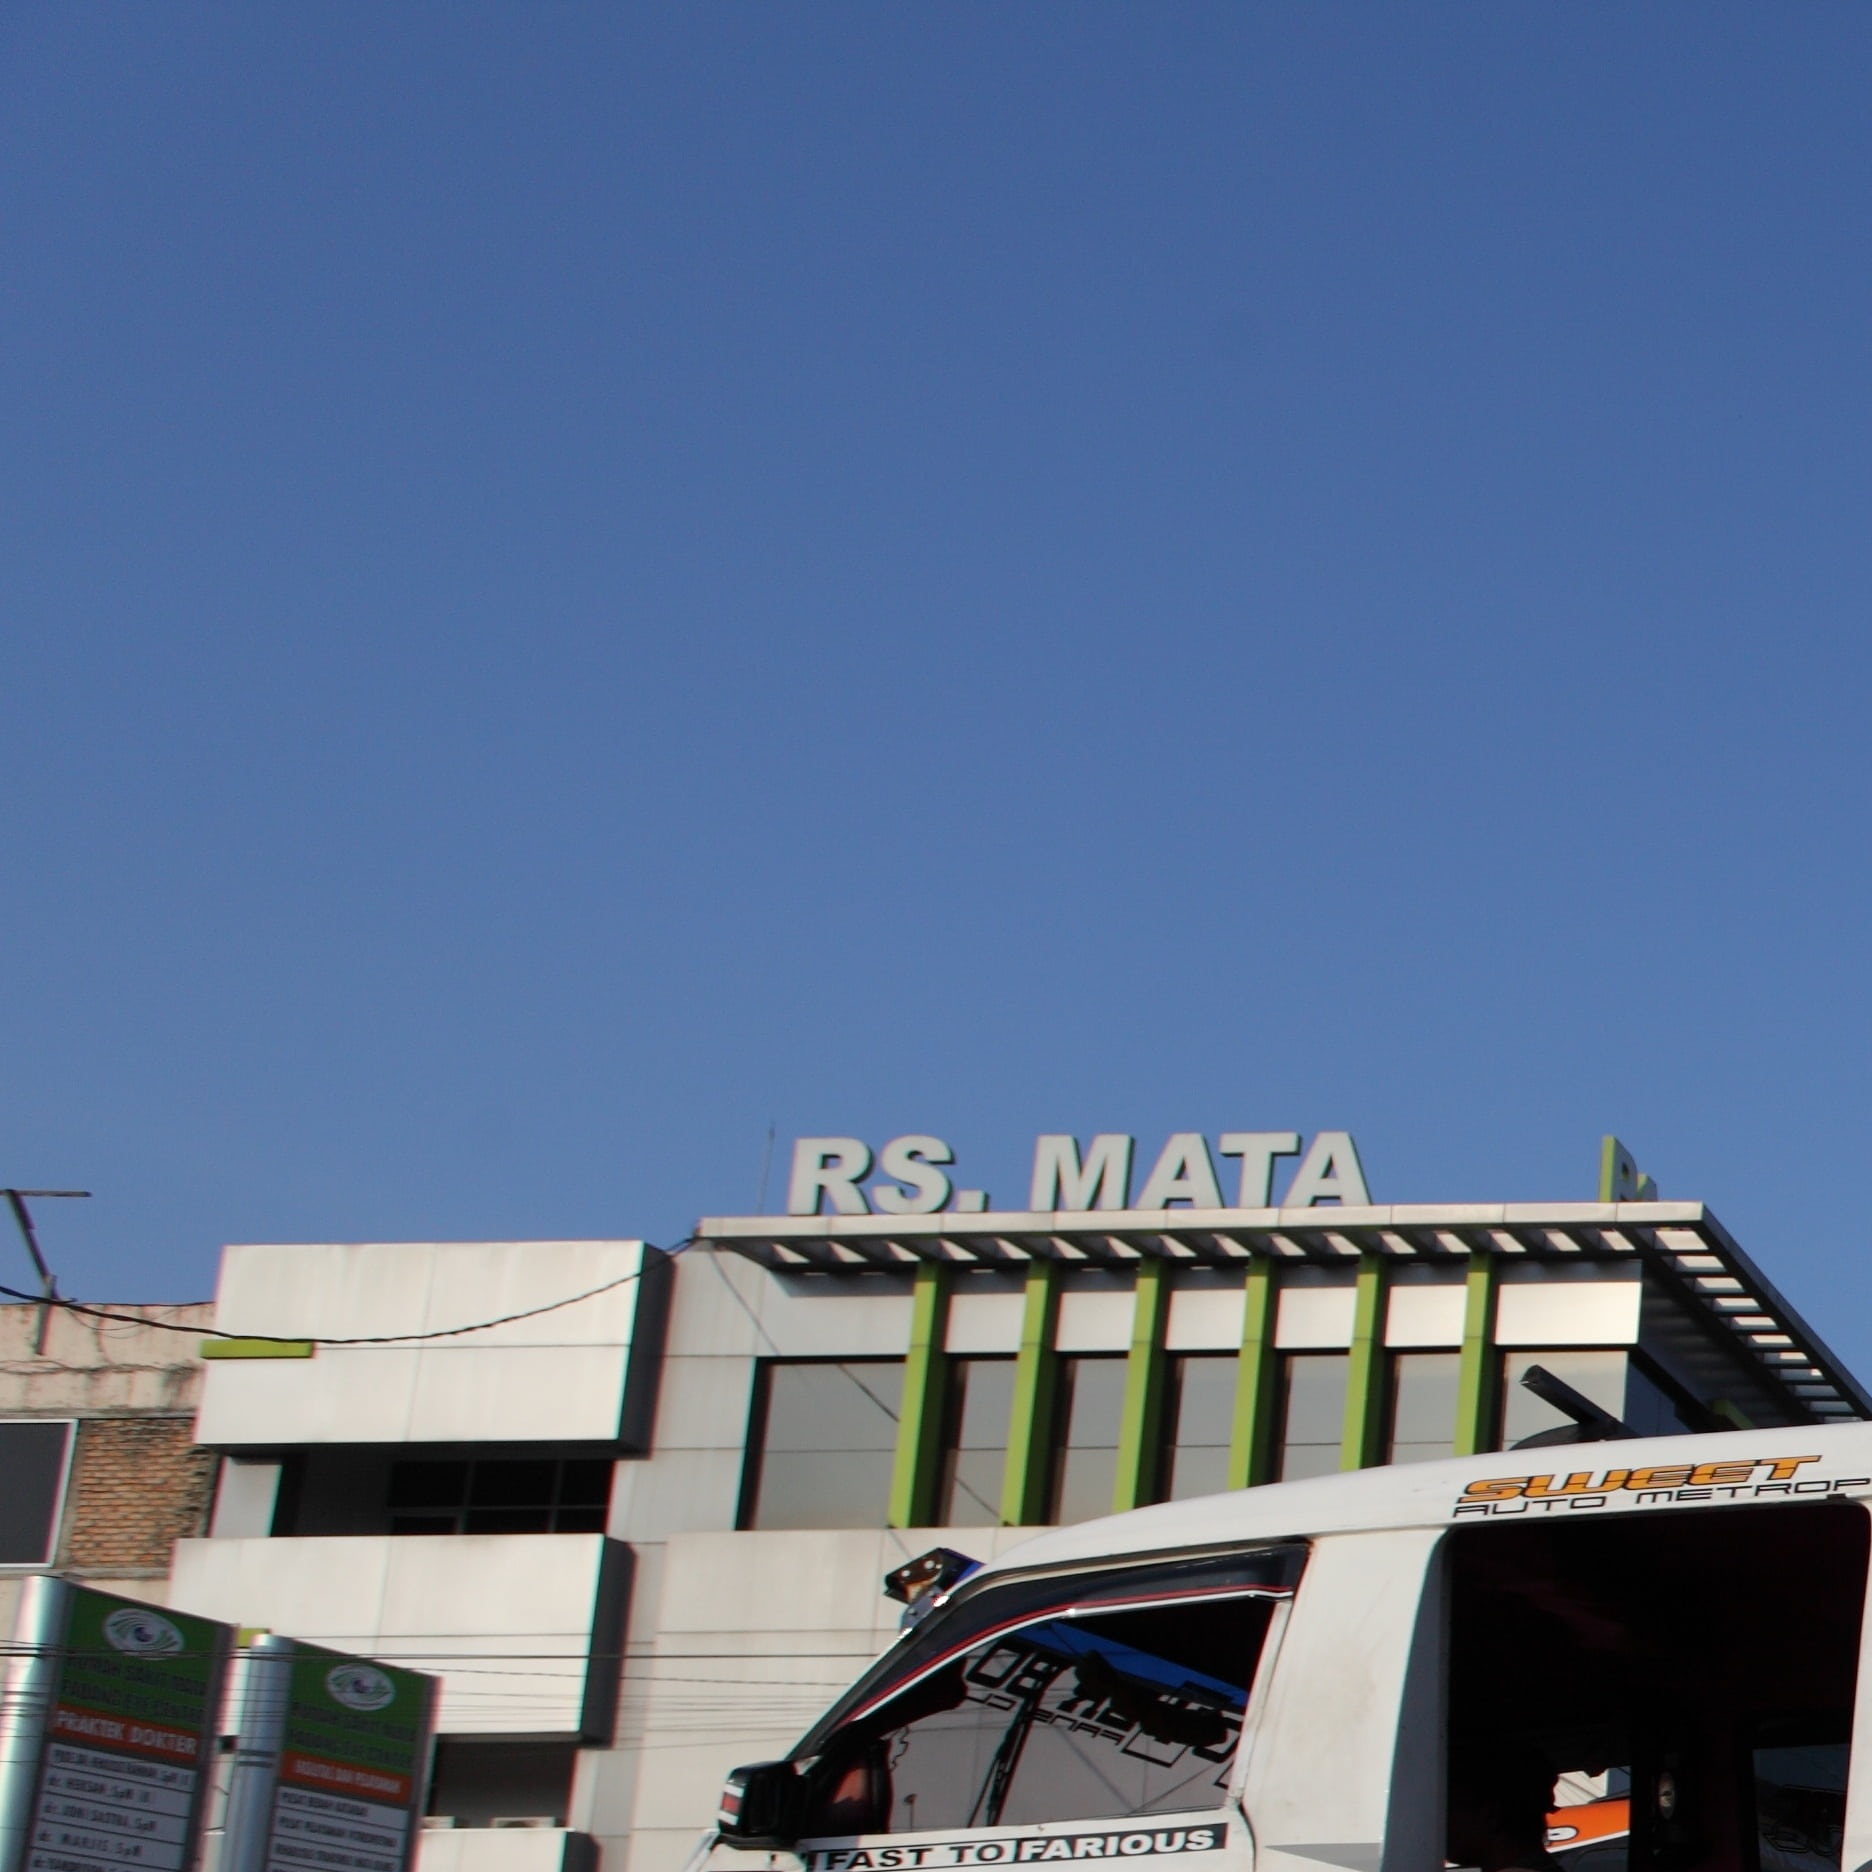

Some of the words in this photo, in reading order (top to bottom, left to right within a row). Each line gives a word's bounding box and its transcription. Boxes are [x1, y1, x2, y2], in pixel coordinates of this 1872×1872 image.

[788, 1135, 988, 1216] RS.
[1031, 1131, 1375, 1212] MATA
[1468, 1454, 1820, 1500] SWEET
[1454, 1495, 1618, 1518] AUTO
[55, 1709, 125, 1742] PRAKTEK
[130, 1726, 199, 1756] DOKTER
[826, 1847, 927, 1872] FAST
[947, 1838, 1013, 1864] TO
[1018, 1828, 1214, 1860] FARIOUS
